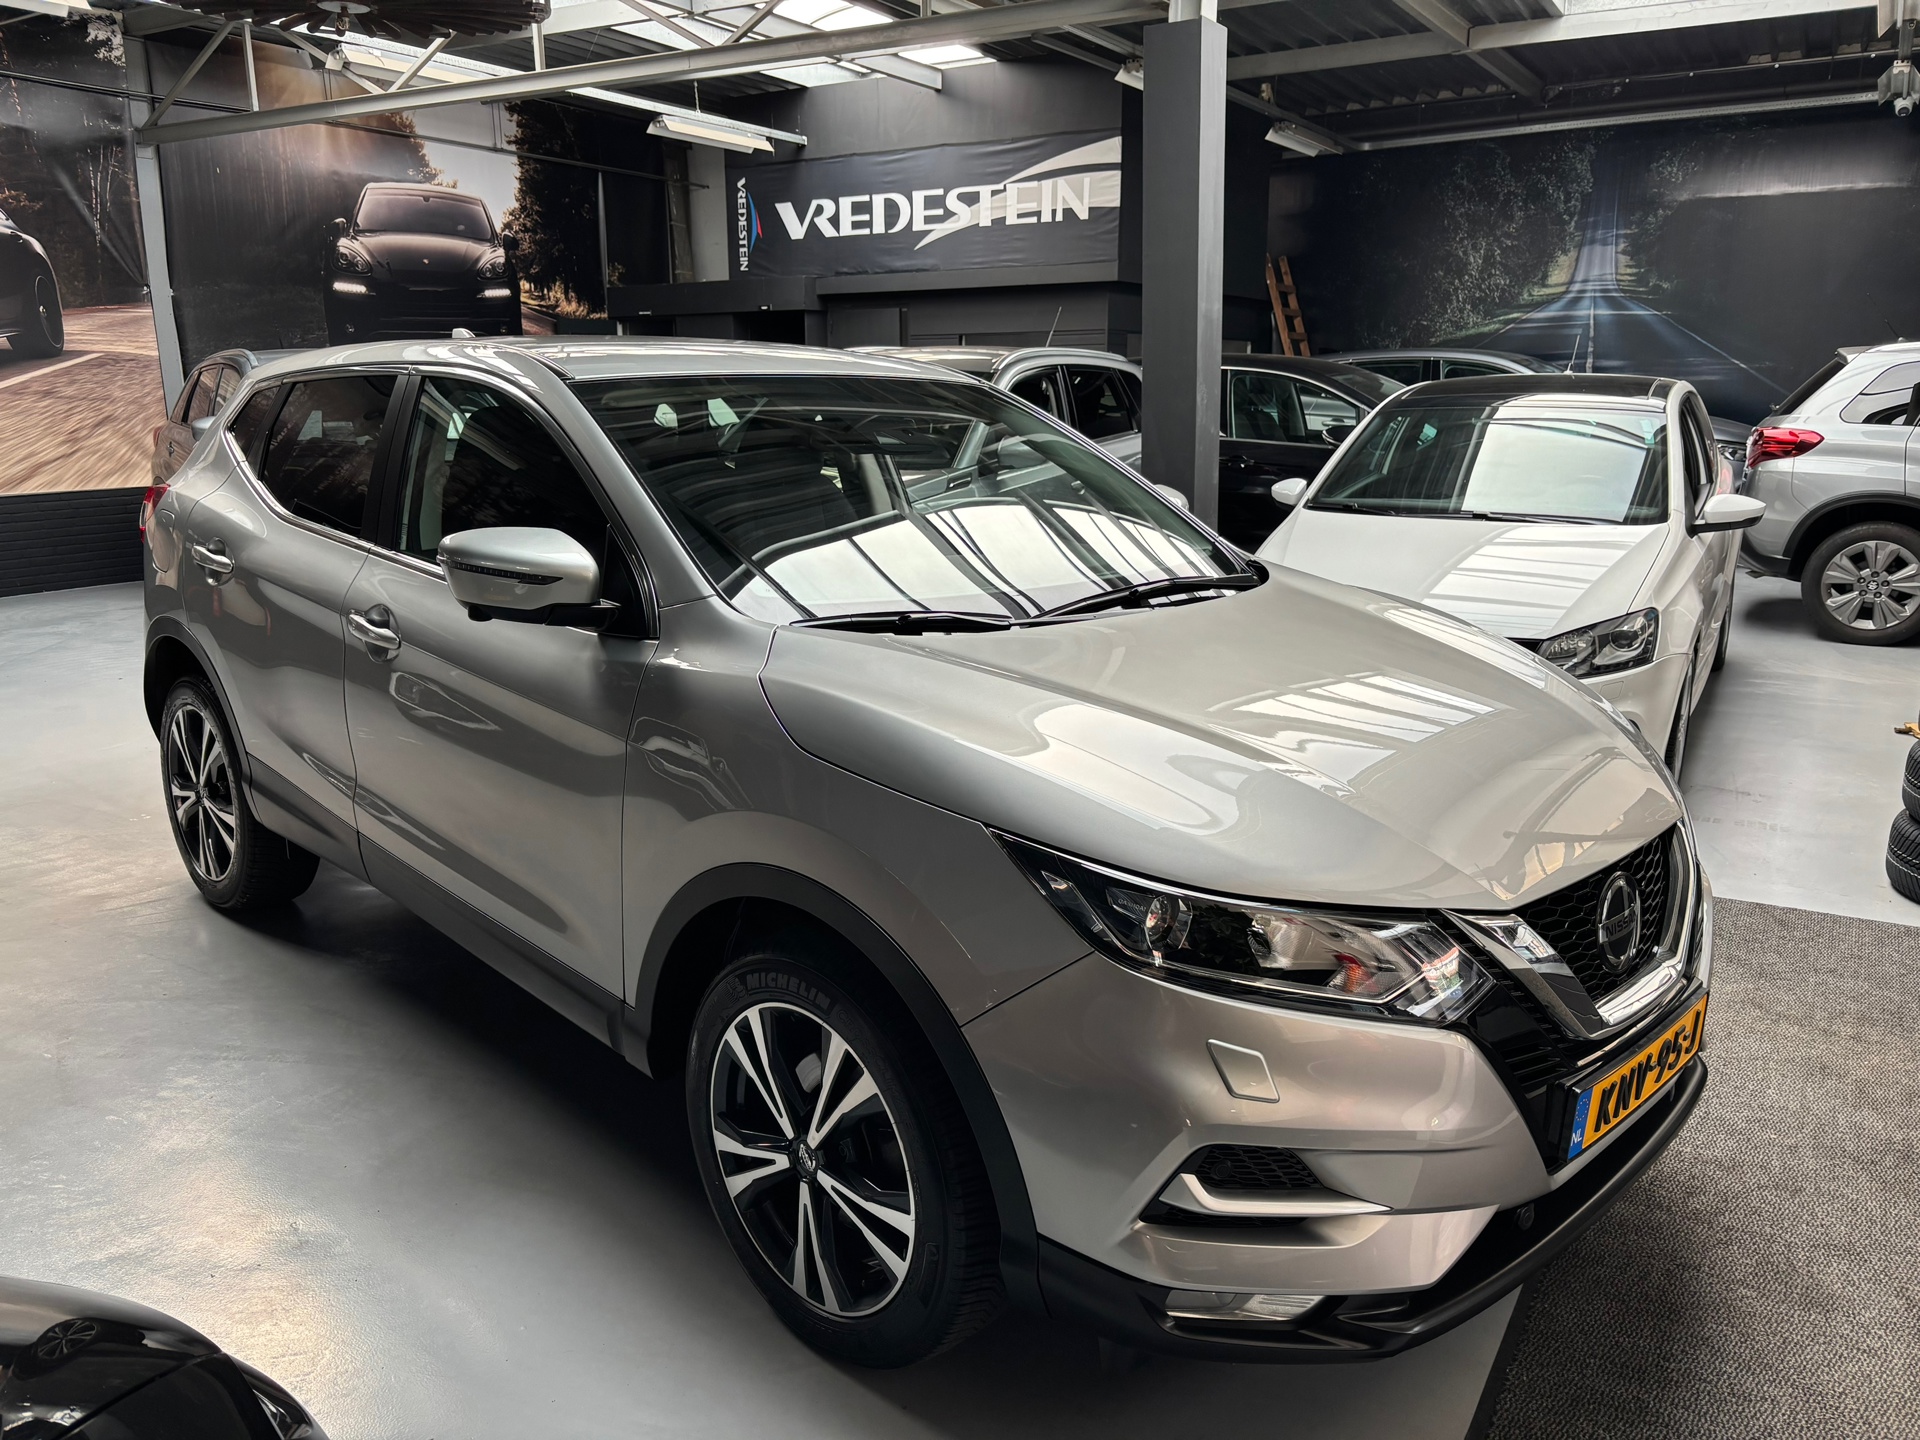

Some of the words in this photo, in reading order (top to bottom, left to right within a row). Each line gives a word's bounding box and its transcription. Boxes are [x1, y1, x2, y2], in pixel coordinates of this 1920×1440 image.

[736, 176, 749, 272] VREDESTEIN
[774, 176, 1091, 241] VREDESTEIN
[1604, 913, 1636, 939] NISSA
[745, 971, 831, 1011] MICHELIN
[1593, 1009, 1703, 1133] KNV-95-J
[1570, 1128, 1583, 1147] NL
